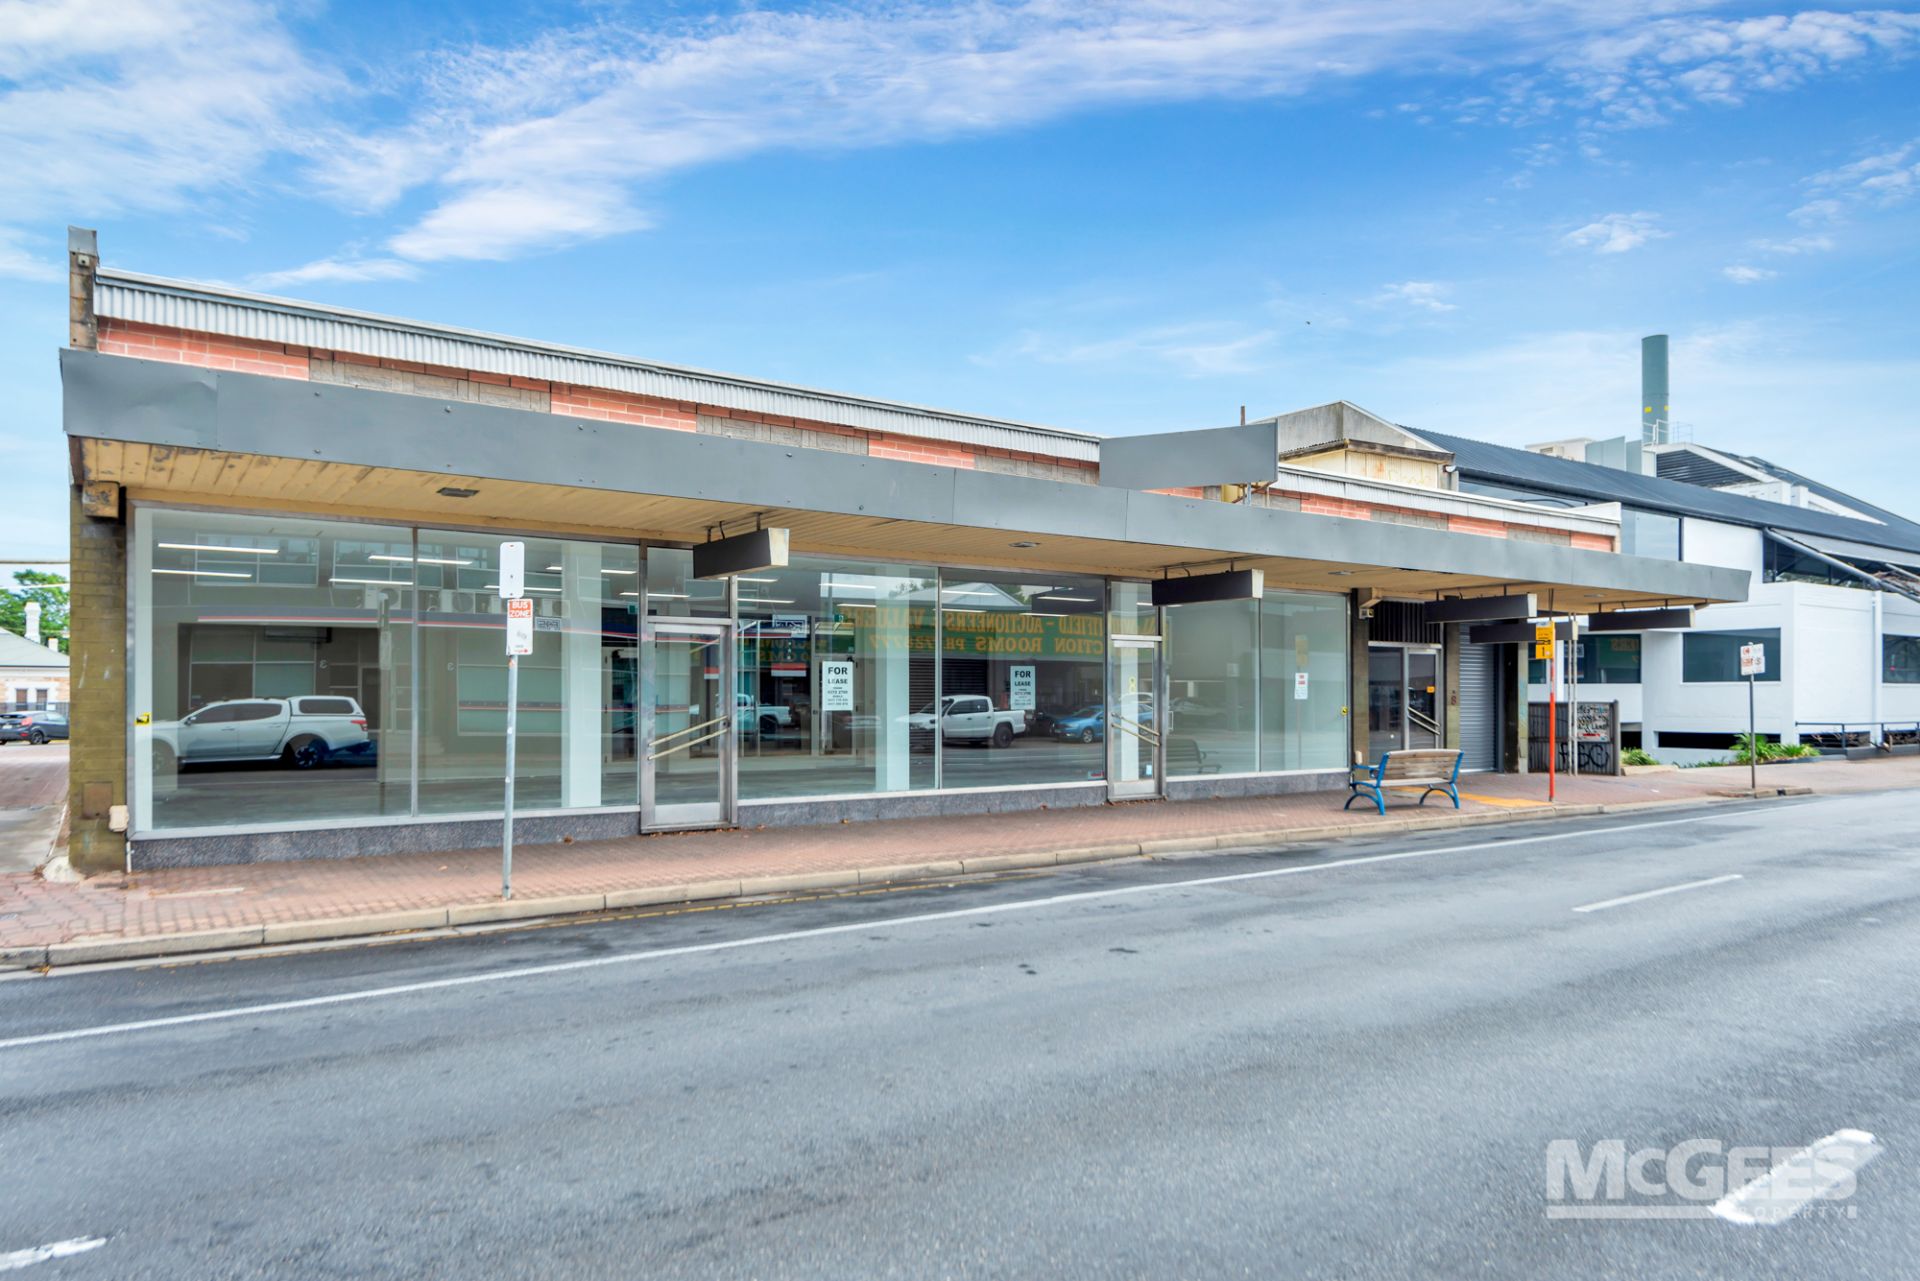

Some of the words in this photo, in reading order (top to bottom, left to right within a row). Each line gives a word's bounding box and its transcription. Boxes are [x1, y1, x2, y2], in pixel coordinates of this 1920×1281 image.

[512, 600, 529, 609] BUS
[509, 610, 531, 618] ZONE
[827, 666, 848, 675] FOR
[1014, 670, 1032, 678] FOR
